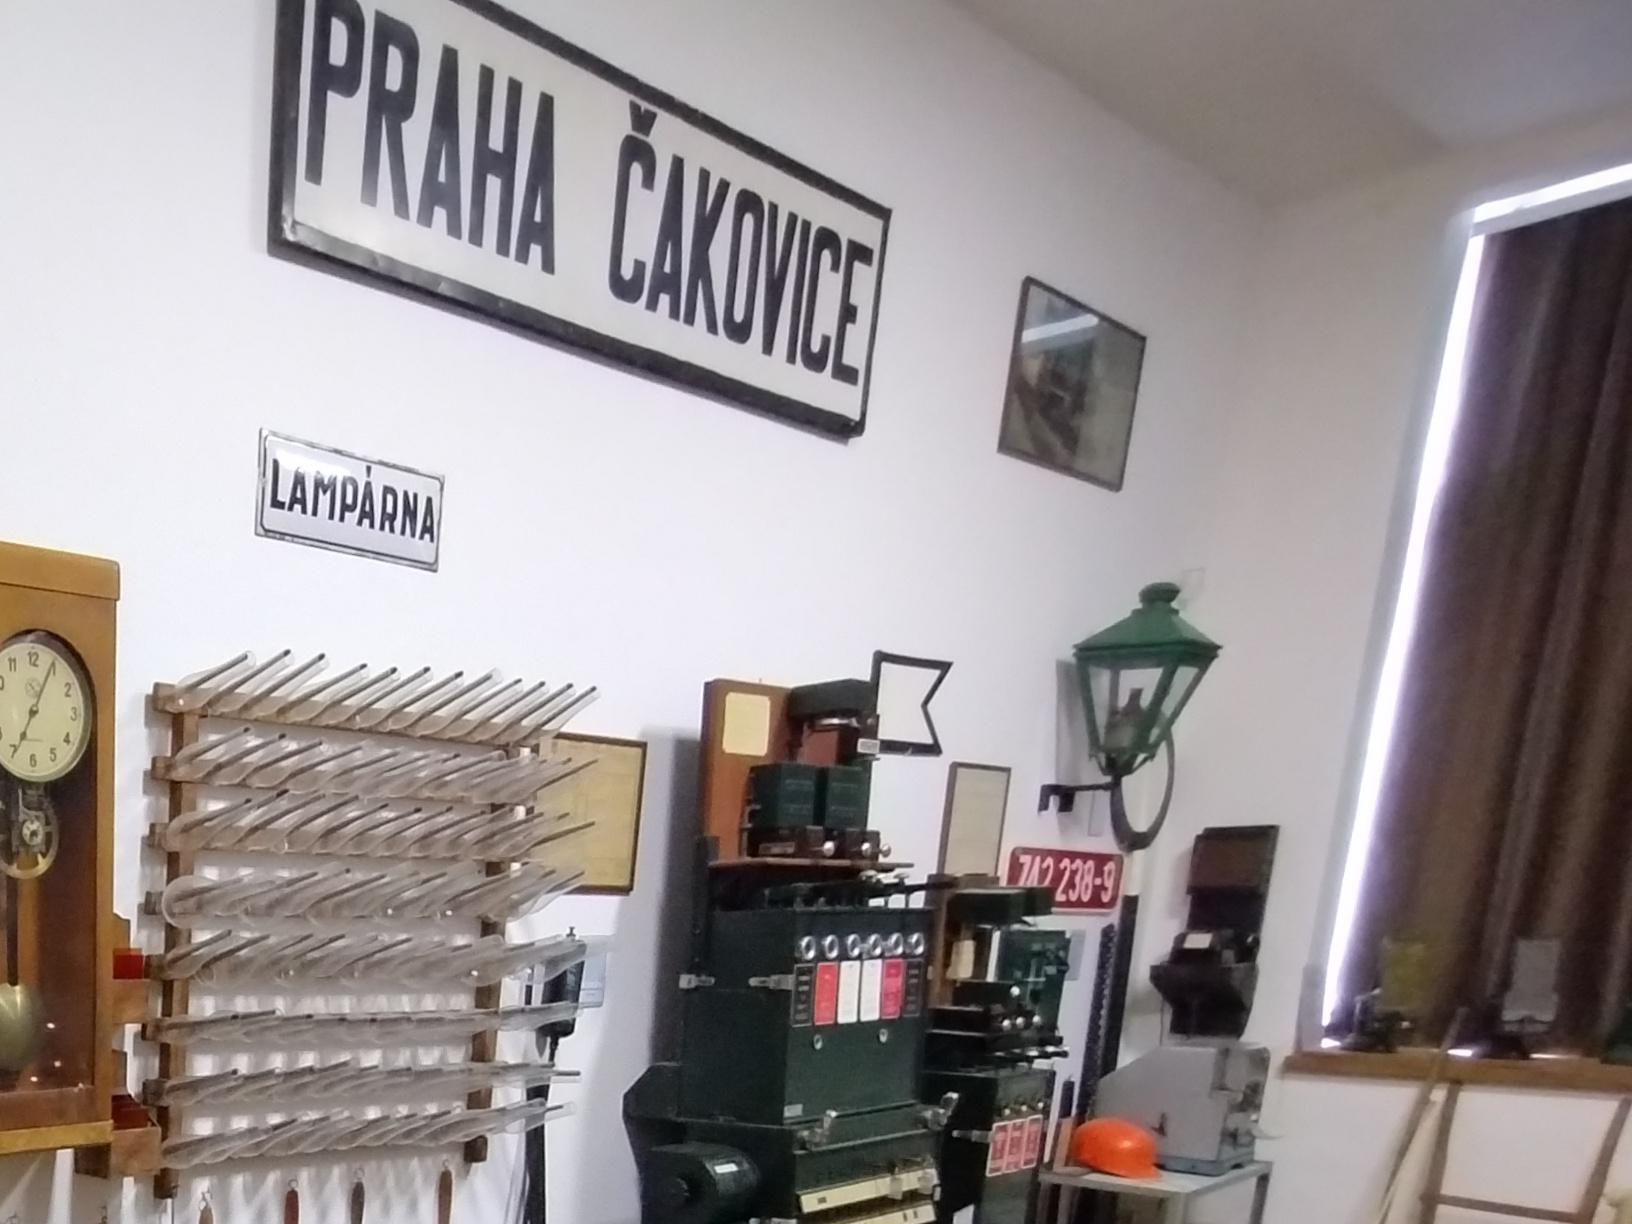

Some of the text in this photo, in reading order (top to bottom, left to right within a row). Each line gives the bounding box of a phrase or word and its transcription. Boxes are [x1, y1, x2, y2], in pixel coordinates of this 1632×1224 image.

[304, 0, 874, 387] PRAHA ČAKOVICE
[270, 457, 435, 544] LAMPÁRNA
[1054, 857, 1116, 903] 238-9
